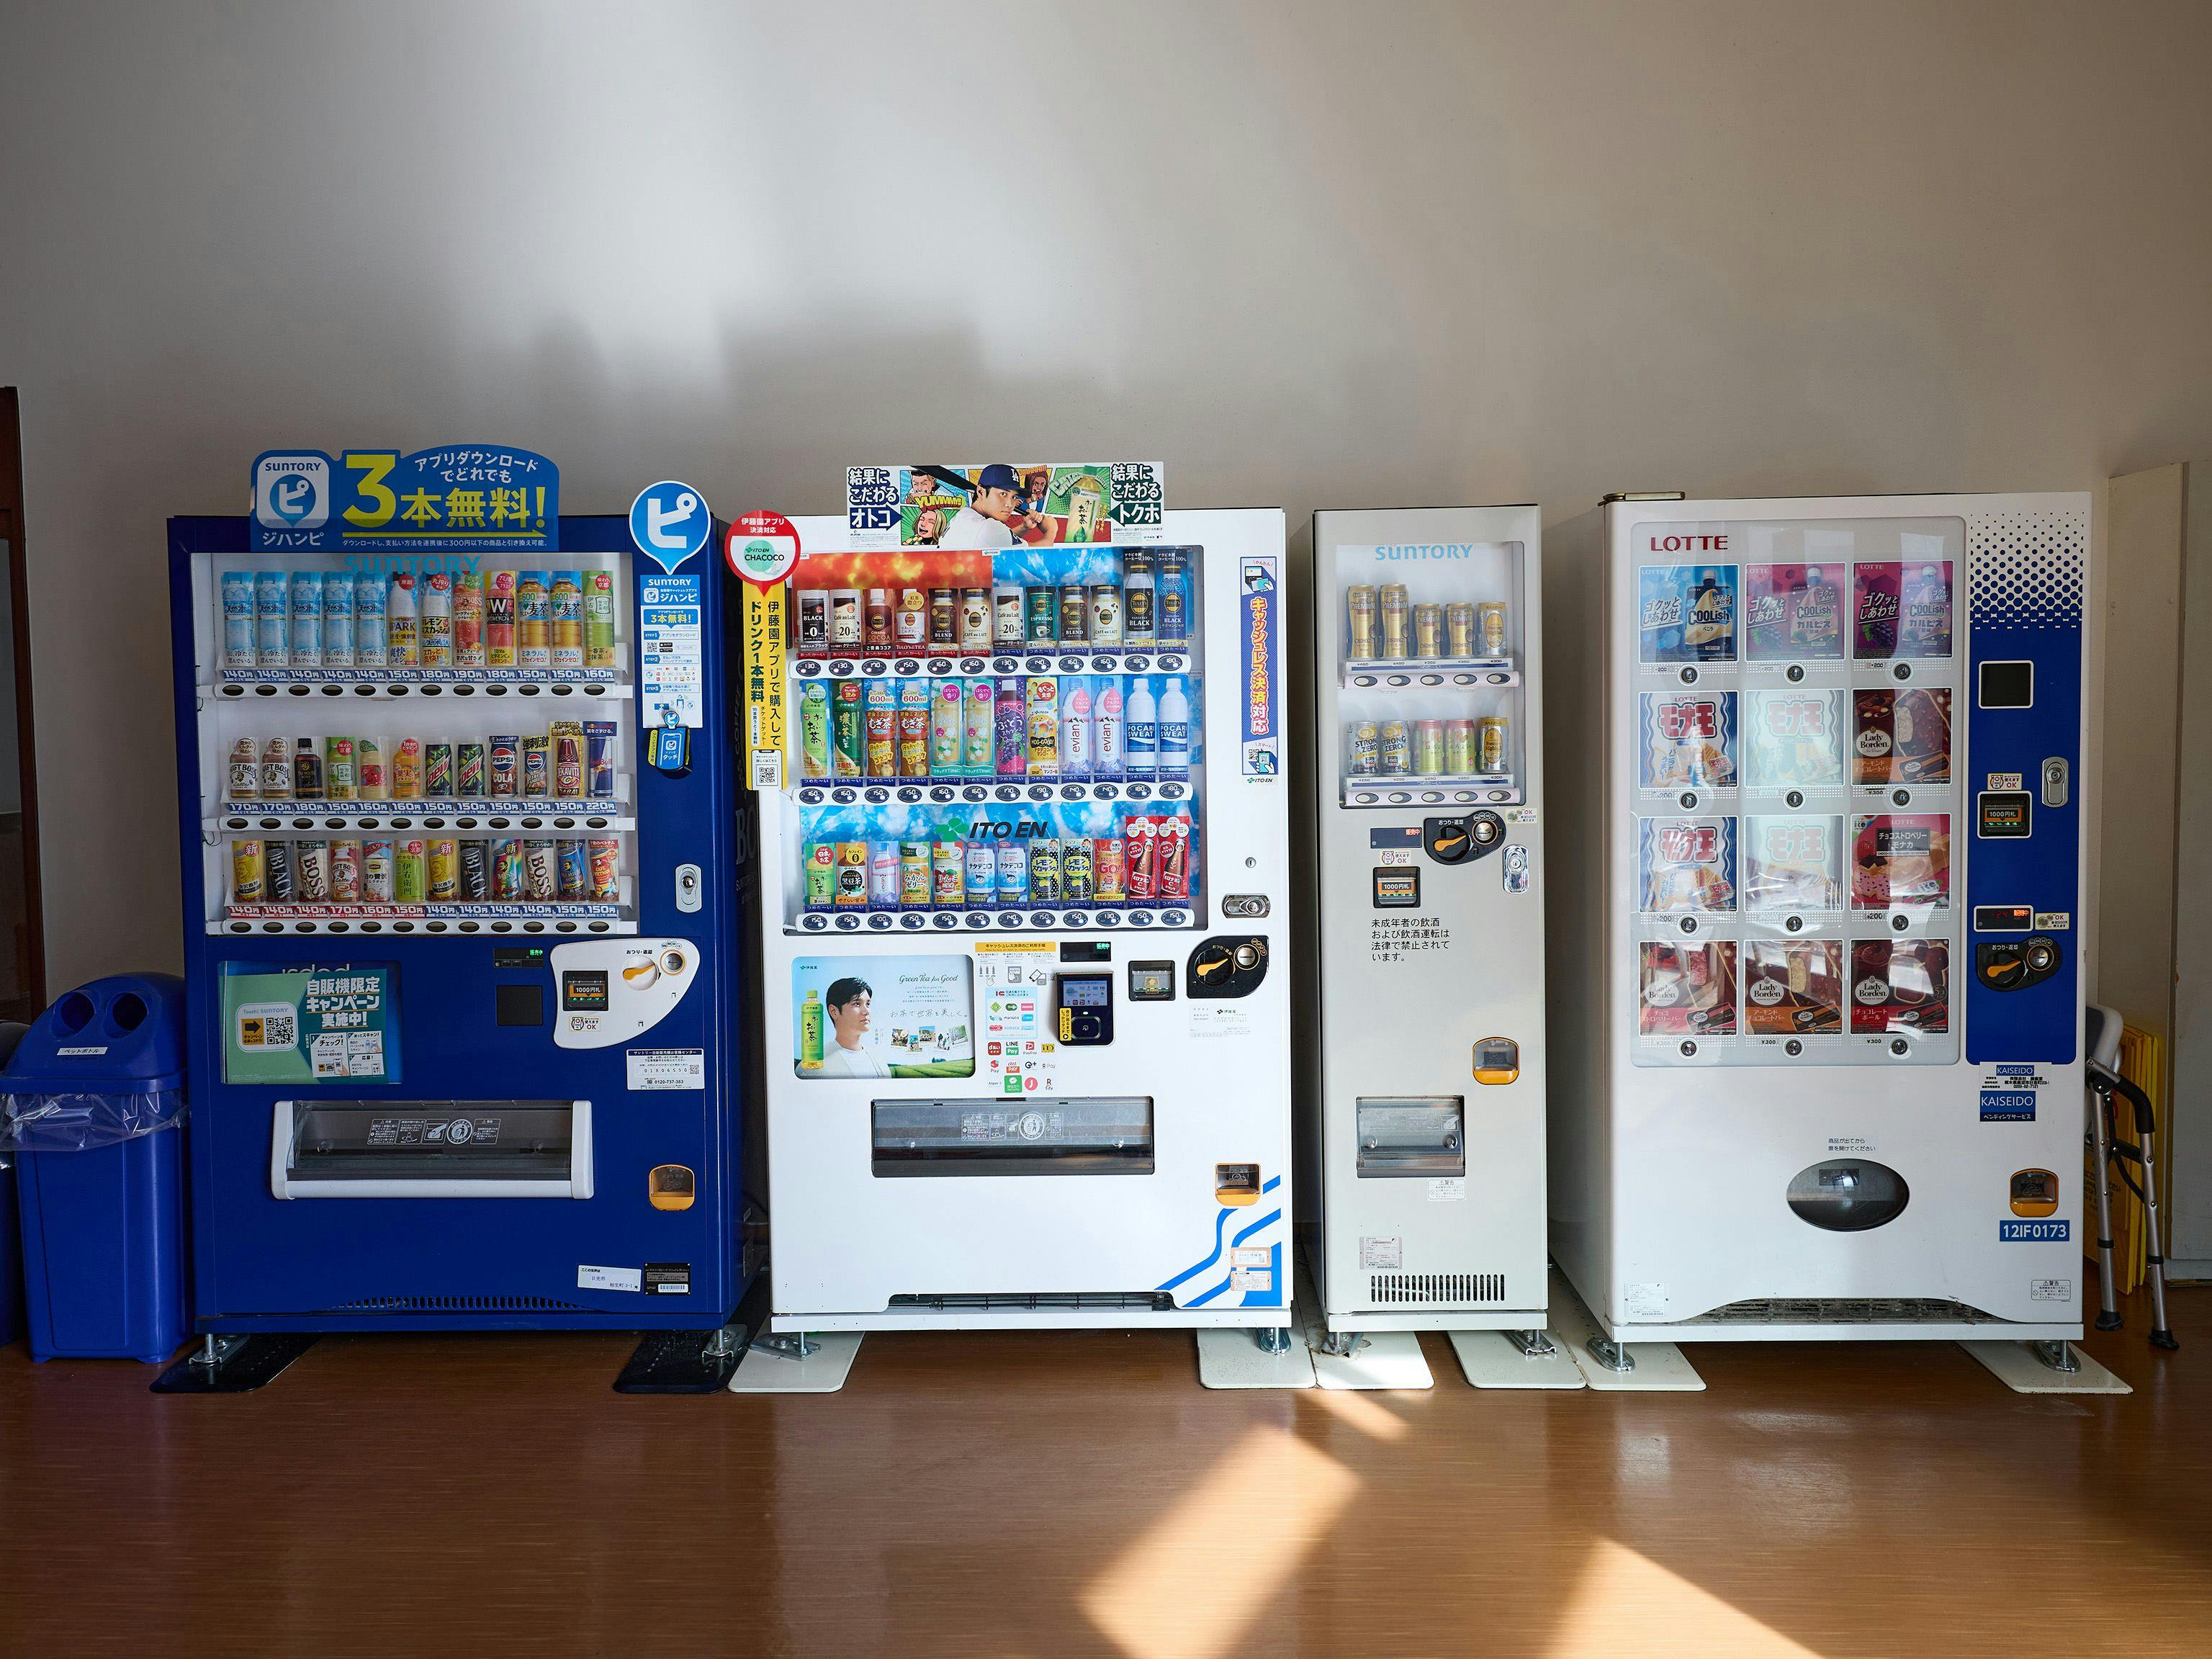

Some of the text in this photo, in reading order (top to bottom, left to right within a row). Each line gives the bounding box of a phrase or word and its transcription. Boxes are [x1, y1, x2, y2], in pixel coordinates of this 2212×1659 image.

[415, 451, 538, 472] アプリダウンロード
[441, 469, 512, 483] でどれでも
[849, 469, 888, 485] 結果に
[1011, 469, 1019, 482] LA
[1112, 465, 1151, 481] 結果に
[850, 487, 897, 503] こだわる
[1112, 483, 1159, 498] こだわる
[648, 493, 697, 548] ピ
[852, 510, 891, 528] オトコ
[1120, 505, 1159, 523] トクホ
[263, 532, 323, 545] ジハンピ
[1650, 536, 1728, 552] LOTTE
[1375, 544, 1475, 560] SUNTORY
[345, 556, 480, 575] SUNTORY
[490, 599, 507, 612] W
[1645, 596, 1681, 612] ゴクッと
[1750, 596, 1785, 612] ゴクッと
[1862, 593, 1899, 608] ゴクッと
[529, 603, 548, 616] 麦茶
[561, 603, 580, 616] 麦茶
[1643, 609, 1679, 625] しあわせ
[1748, 608, 1784, 624] しあわせ
[1797, 605, 1831, 619] COOLish
[1859, 604, 1898, 620] しあわせ
[1910, 605, 1944, 618] COOLish
[1688, 610, 1730, 626] COOLish
[1003, 624, 1014, 634] 20
[750, 601, 764, 702] ドリンク1本無料
[768, 601, 781, 746] 伊藤園アプリで購入して
[1251, 597, 1267, 734] キャッシュレス決済対応
[868, 718, 892, 729] むぎ茶
[1660, 704, 1715, 737] モナ王
[523, 736, 549, 750] 強刺激
[1071, 724, 1080, 752] evian
[1102, 723, 1110, 752] evian
[493, 773, 512, 783] COLA
[969, 822, 1048, 838] ITO EN
[246, 844, 256, 856] 新
[441, 843, 451, 854] 新
[505, 842, 517, 854] 新
[270, 853, 288, 899] BLACK
[304, 856, 324, 899] BOSS
[403, 863, 412, 896] 伊右衛門
[466, 853, 486, 898] BLACK
[531, 855, 552, 896] BOSS
[1371, 918, 1439, 927] 未成年者の飲酒
[1372, 930, 1449, 939] および飲酒運転は
[1371, 940, 1449, 950] 法律で禁止されて
[1372, 953, 1405, 962] います。
[307, 977, 379, 994] 自販機限定
[899, 974, 918, 984] Green
[919, 973, 930, 982] Tea
[941, 974, 958, 983] Good
[1759, 984, 1778, 992] Lady
[307, 995, 379, 1012] キャンペーン
[323, 1012, 367, 1027] 実施中!
[1982, 1097, 2033, 1106] KAISEIDO
[2003, 1224, 2067, 1238] 12IF0173
